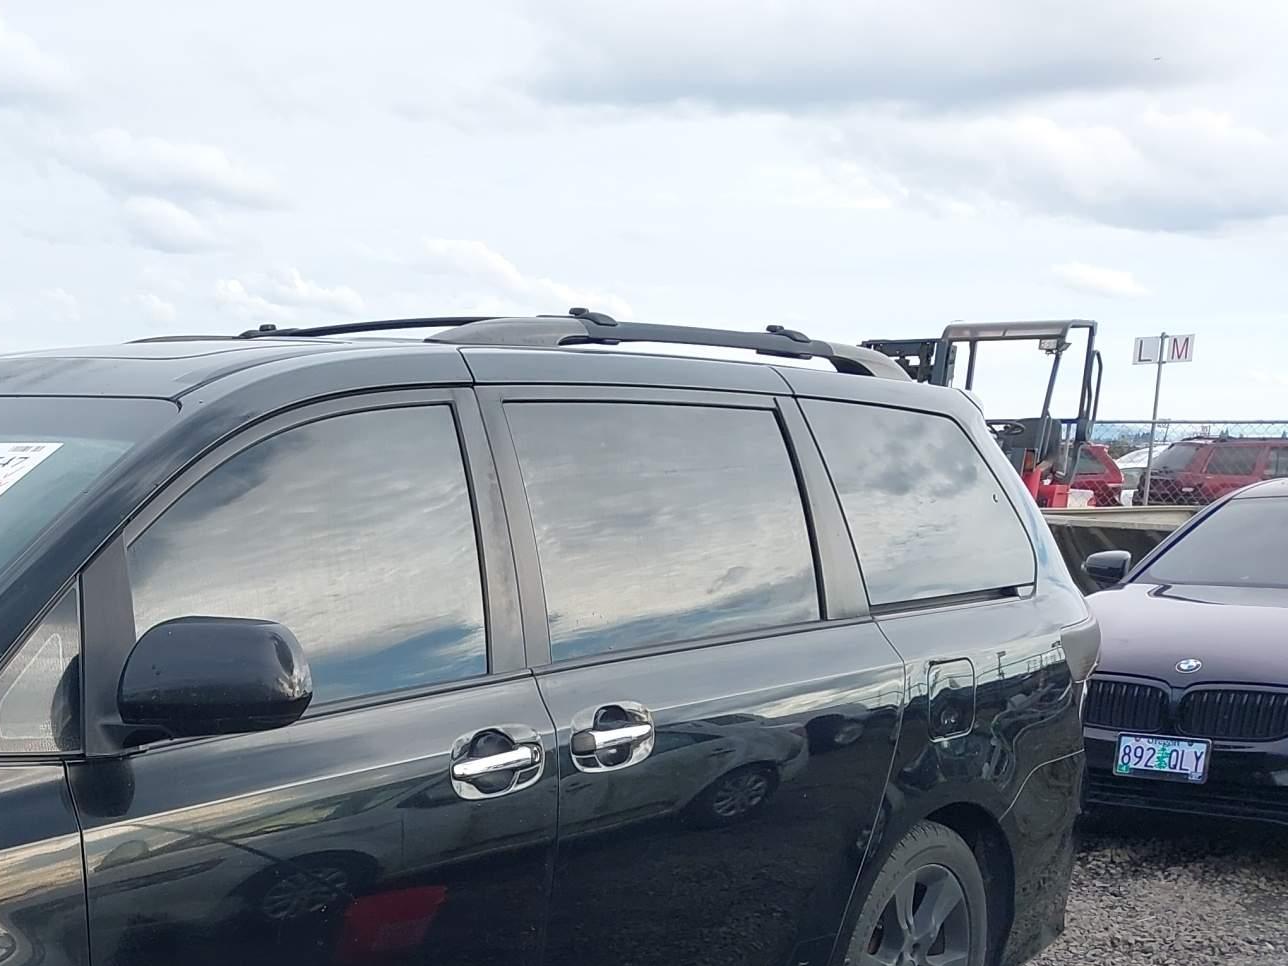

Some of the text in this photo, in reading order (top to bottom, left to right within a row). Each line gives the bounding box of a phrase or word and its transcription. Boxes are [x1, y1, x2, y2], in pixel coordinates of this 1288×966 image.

[1138, 339, 1153, 362] L
[1171, 337, 1189, 360] M
[1121, 744, 1156, 768] 892
